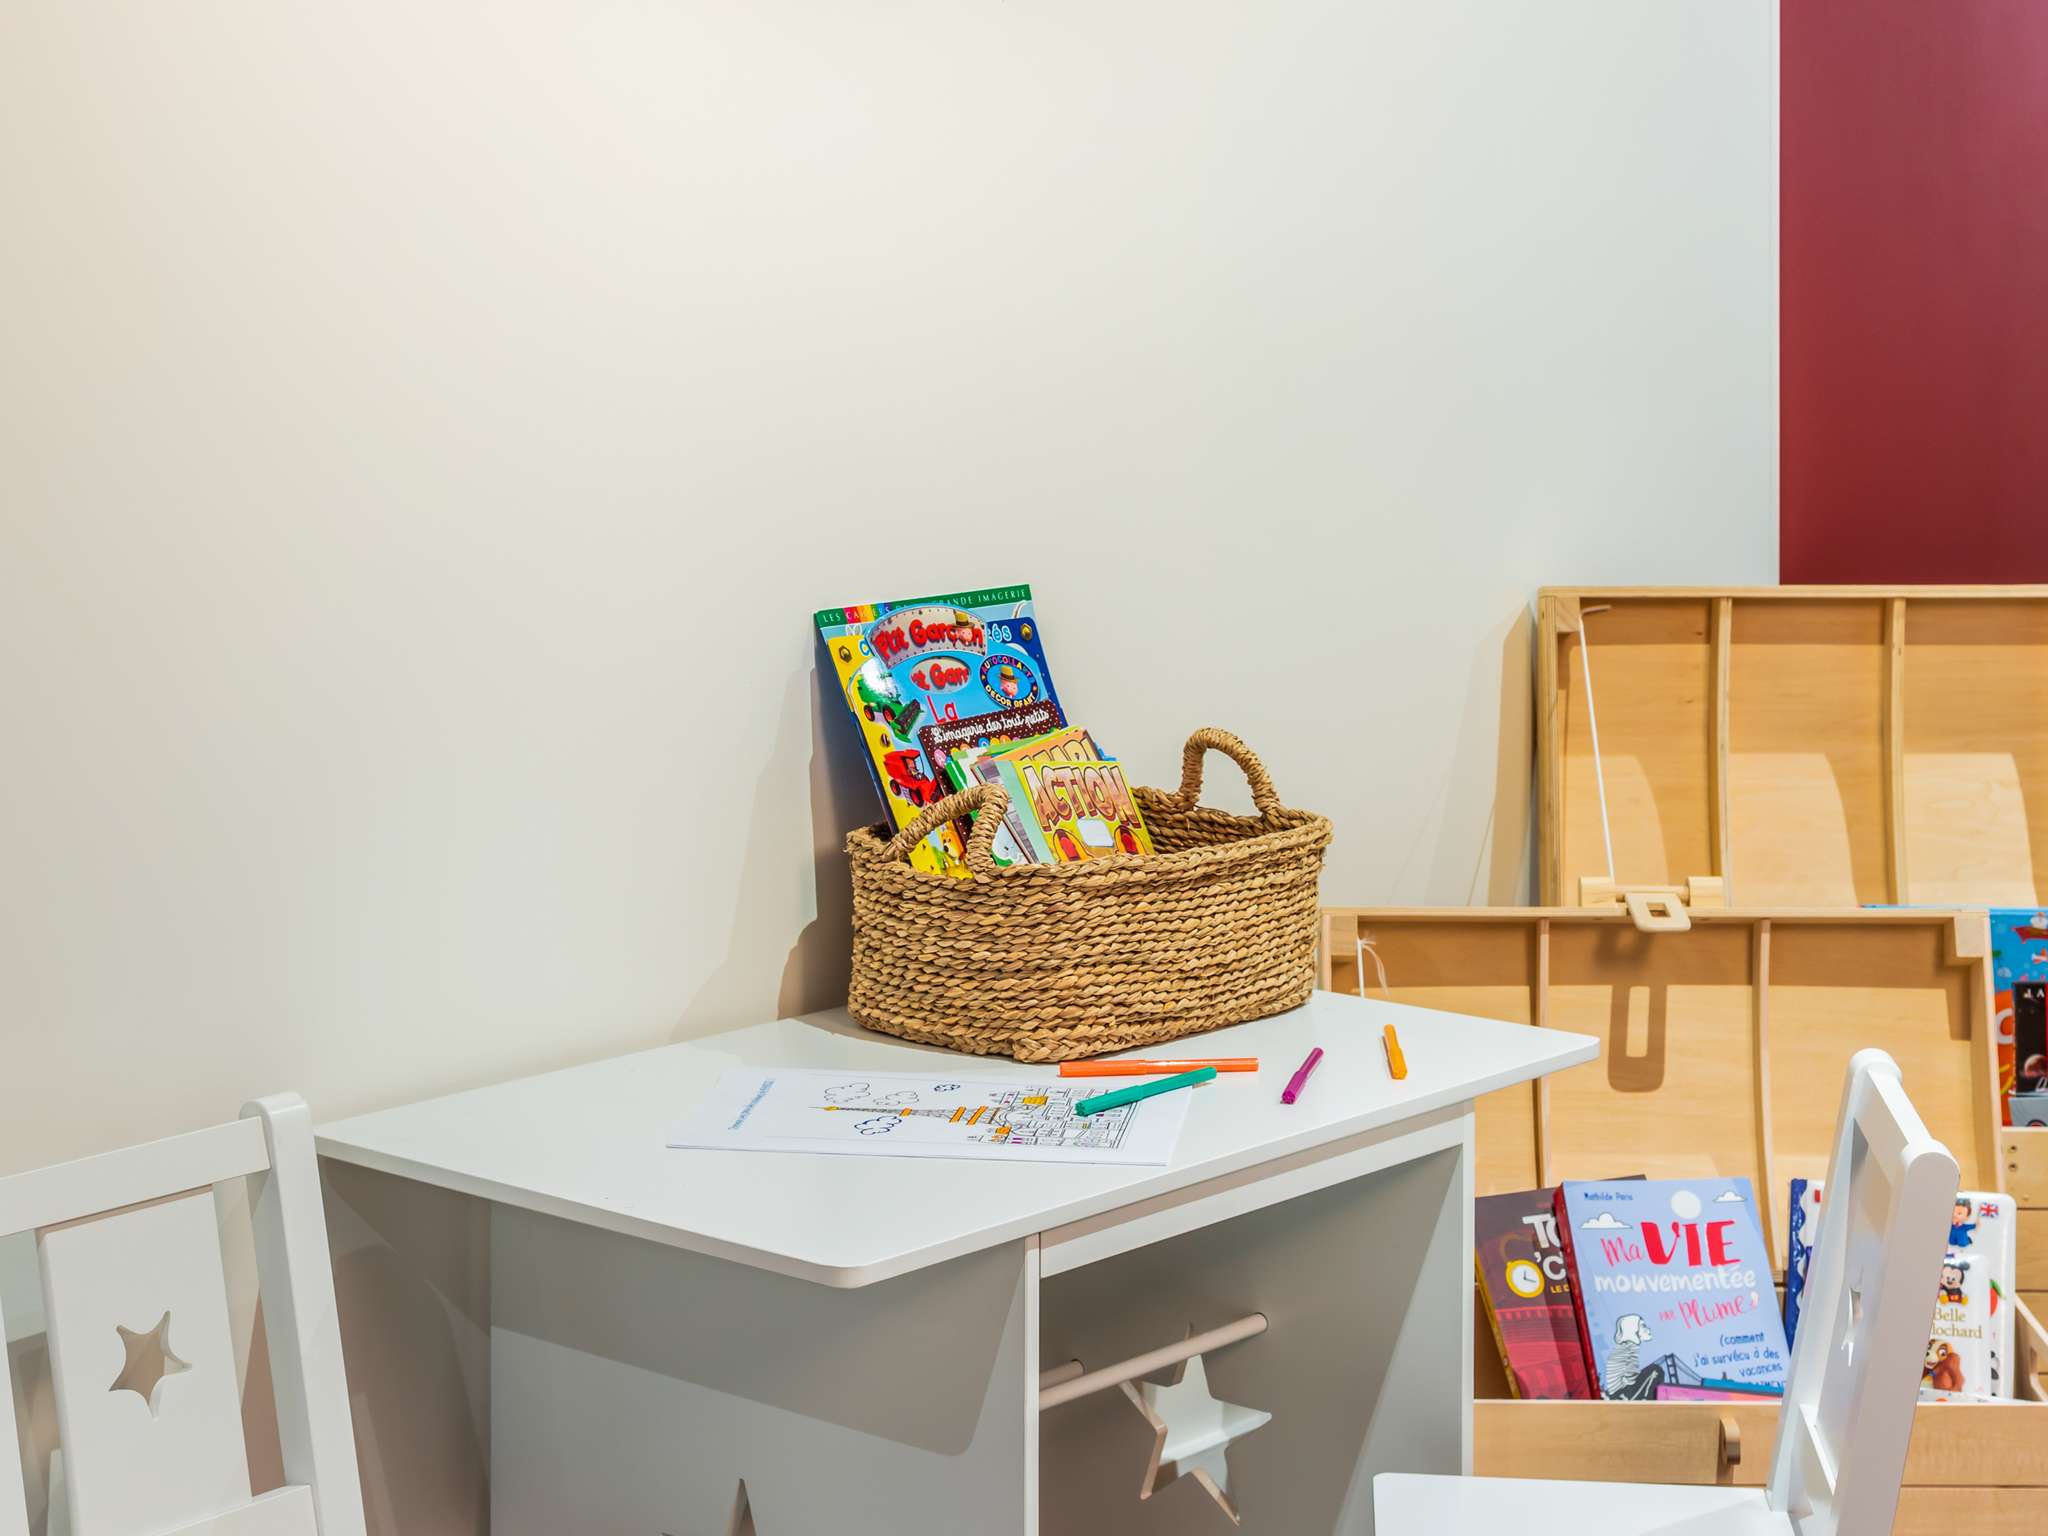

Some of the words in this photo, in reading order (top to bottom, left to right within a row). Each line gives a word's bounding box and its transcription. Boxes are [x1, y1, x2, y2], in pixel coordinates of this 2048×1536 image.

[978, 588, 1027, 603] IMAGERIE
[909, 618, 984, 649] Garçn
[926, 694, 959, 724] La
[986, 718, 1003, 733] des
[1022, 765, 1142, 832] ACTION
[1601, 1236, 1643, 1267] Ma
[1640, 1219, 1743, 1267] VIE
[1593, 1264, 1758, 1293] mouvementée
[1931, 1323, 1984, 1339] lochard
